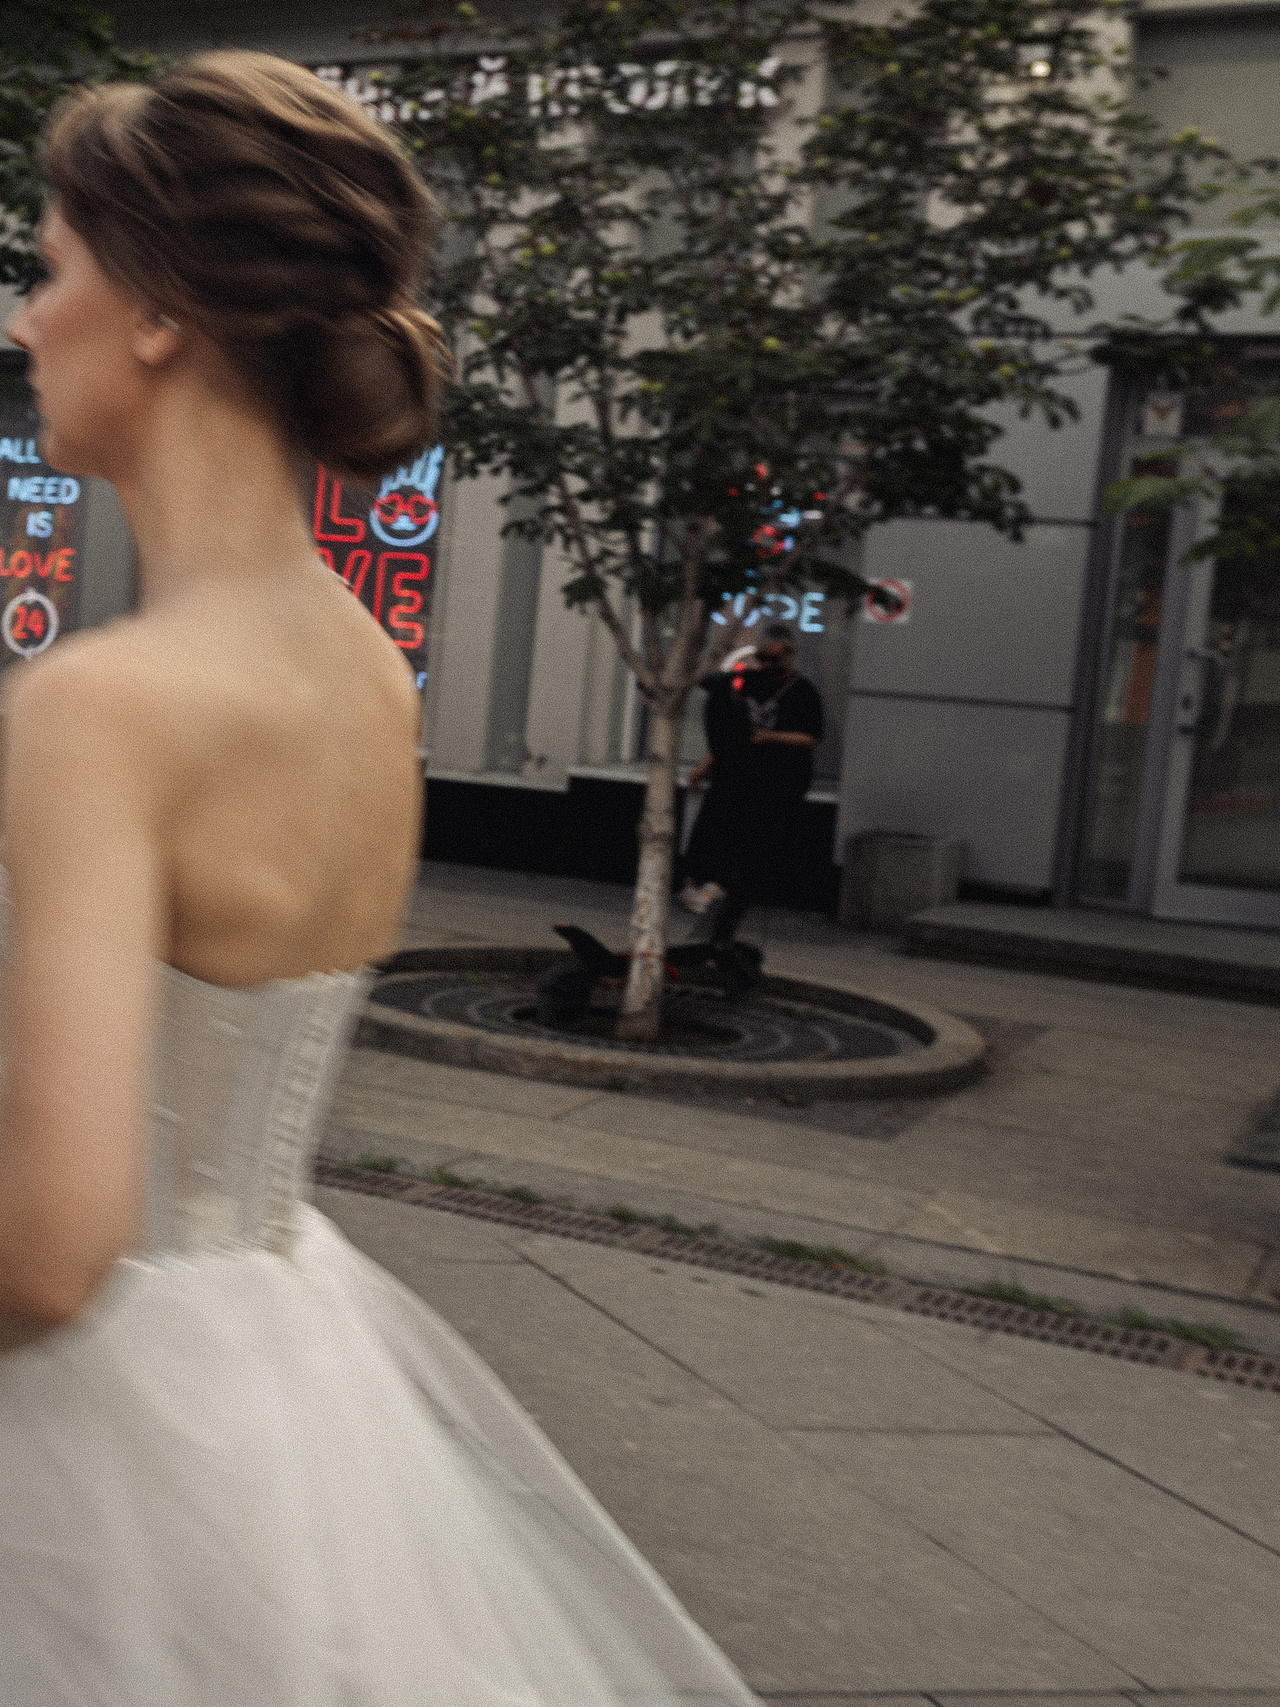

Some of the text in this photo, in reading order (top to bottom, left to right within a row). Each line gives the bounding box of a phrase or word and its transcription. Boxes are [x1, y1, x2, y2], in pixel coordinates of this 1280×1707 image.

[7, 476, 80, 505] NEED
[25, 511, 54, 538] IS
[12, 605, 45, 639] 24
